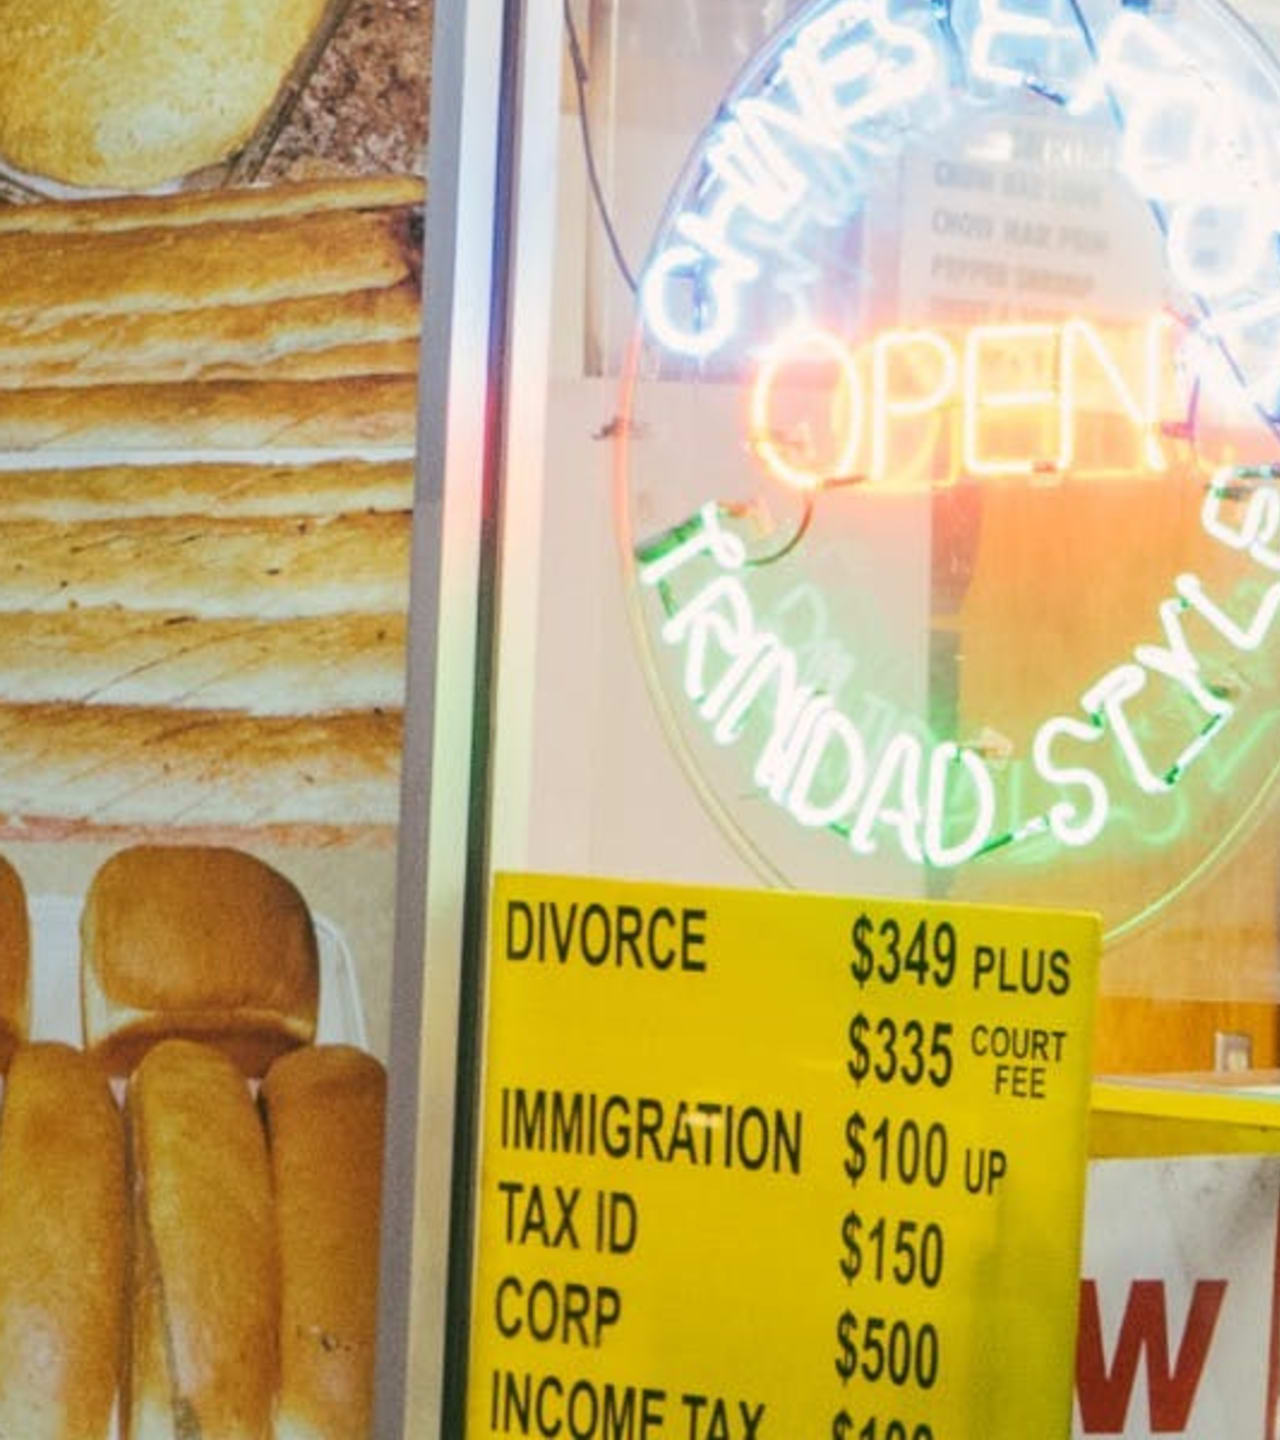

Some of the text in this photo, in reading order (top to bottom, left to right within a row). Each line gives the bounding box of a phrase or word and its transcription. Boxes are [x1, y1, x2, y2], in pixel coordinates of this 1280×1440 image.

[750, 317, 1167, 492] OPEN
[505, 900, 1071, 997] DIVORCE $349 PLUS
[847, 1012, 1068, 1088] $335 COURT
[994, 1063, 1047, 1100] FEE
[501, 1087, 1008, 1197] IMMIGRATION $100 UP
[498, 1181, 945, 1289] TAX ID $150
[493, 1275, 940, 1390] CORP $500
[491, 1369, 667, 1440] INCOME
[682, 1393, 767, 1440] TAX
